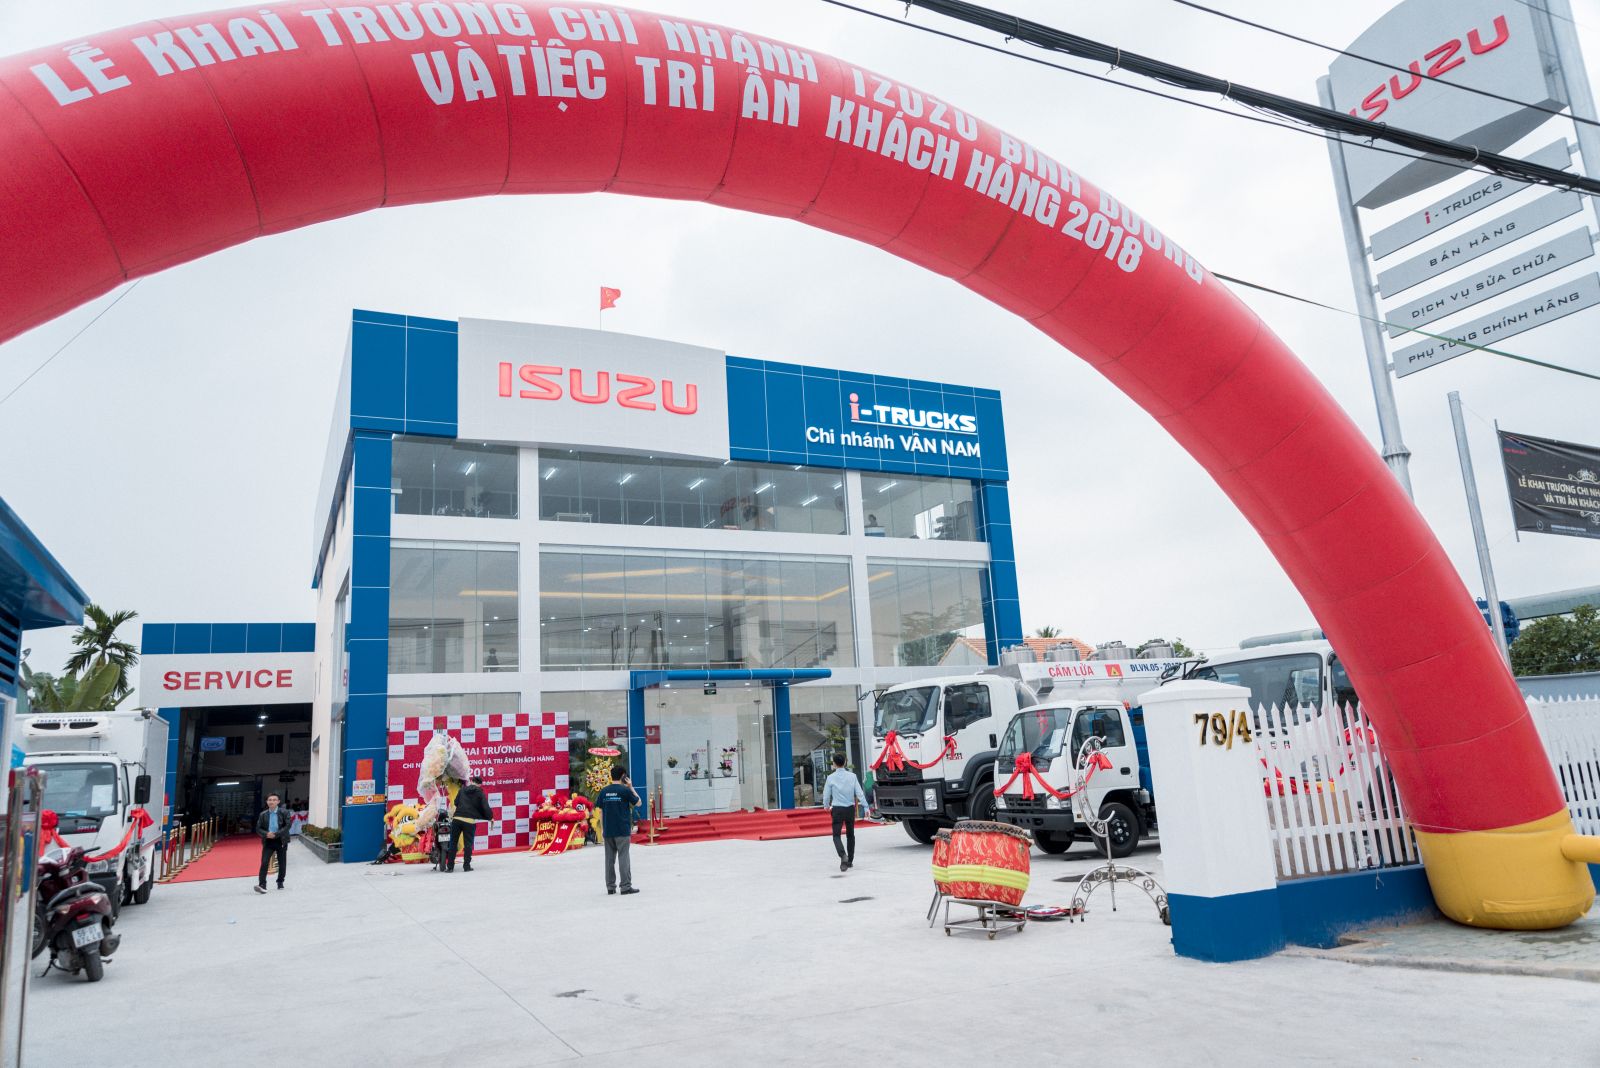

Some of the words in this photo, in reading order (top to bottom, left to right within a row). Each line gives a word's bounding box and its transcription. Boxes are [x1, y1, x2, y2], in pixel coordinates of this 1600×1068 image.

[411, 41, 497, 106] VÀ
[742, 65, 800, 128] ÂN
[825, 94, 960, 181] KHÁCH
[1061, 201, 1144, 273] 2018
[1429, 247, 1461, 267] BÁN
[1469, 222, 1516, 249] HÀNG
[1411, 299, 1445, 319] DỊCH
[1450, 288, 1470, 301] VỤ
[1408, 348, 1435, 364] PHỤ
[1482, 311, 1529, 335] CHÍNH
[498, 361, 698, 416] ISUZU
[805, 426, 835, 445] Chi
[840, 431, 895, 450] nhánh
[898, 432, 938, 455] VÂN
[940, 439, 981, 458] NAM
[163, 669, 293, 691] SERVICE
[482, 744, 523, 755] TRƯƠNG
[1194, 709, 1253, 751] 79/4
